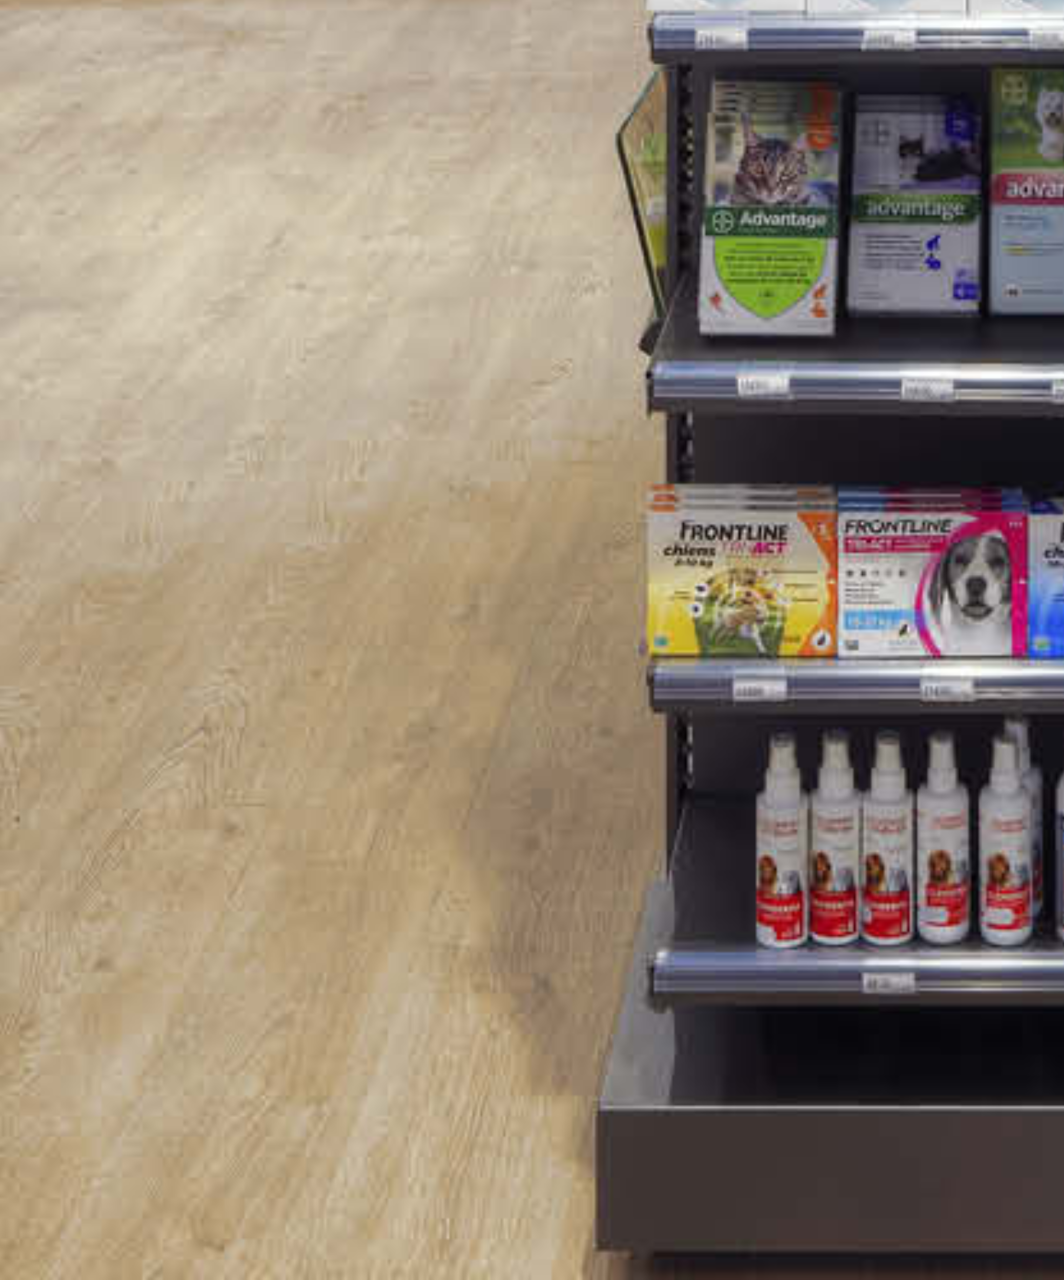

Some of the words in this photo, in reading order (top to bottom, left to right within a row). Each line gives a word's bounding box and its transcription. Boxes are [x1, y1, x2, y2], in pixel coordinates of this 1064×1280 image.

[867, 198, 966, 221] advantage
[740, 210, 828, 229] Advantage
[680, 520, 788, 542] FRONTLINE
[845, 519, 954, 534] FRONTLINE
[663, 544, 717, 557] chiens
